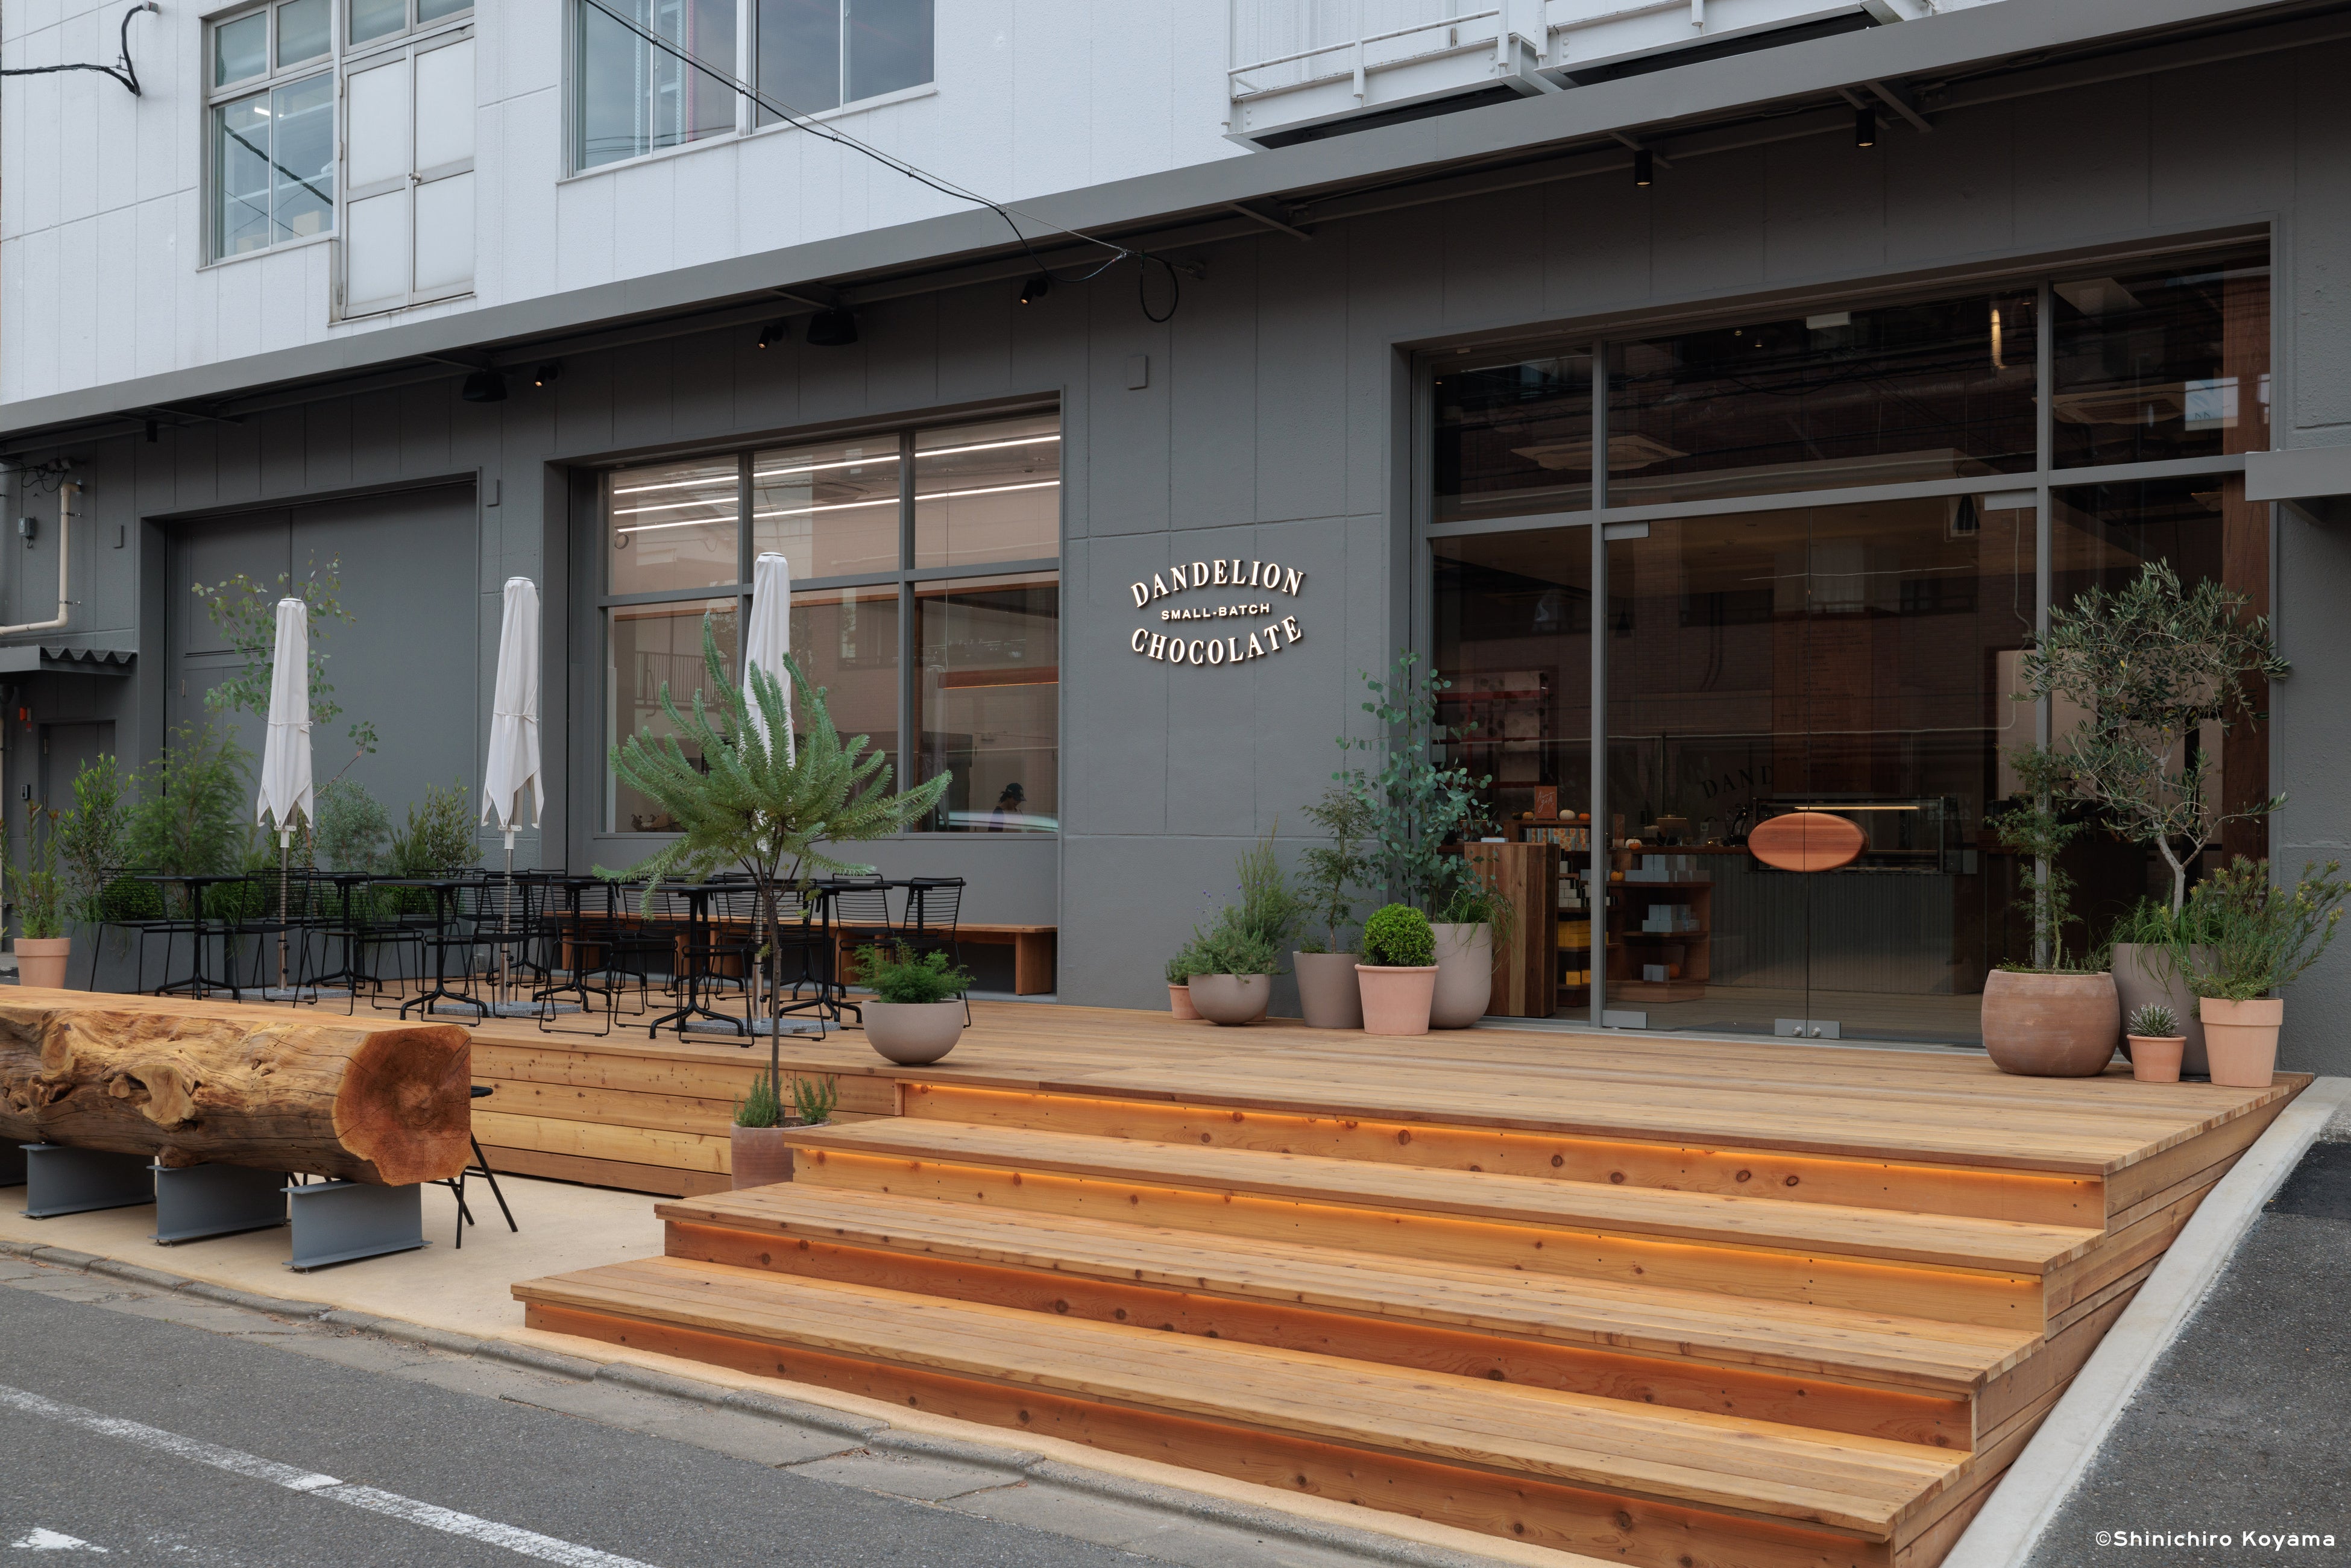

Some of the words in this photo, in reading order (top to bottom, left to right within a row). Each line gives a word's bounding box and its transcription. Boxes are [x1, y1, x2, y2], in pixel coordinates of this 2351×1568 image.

[1130, 559, 1305, 608] DANDELION
[1161, 603, 1271, 621] SMALL-BATCH
[1131, 615, 1303, 665] CHOCOLATE
